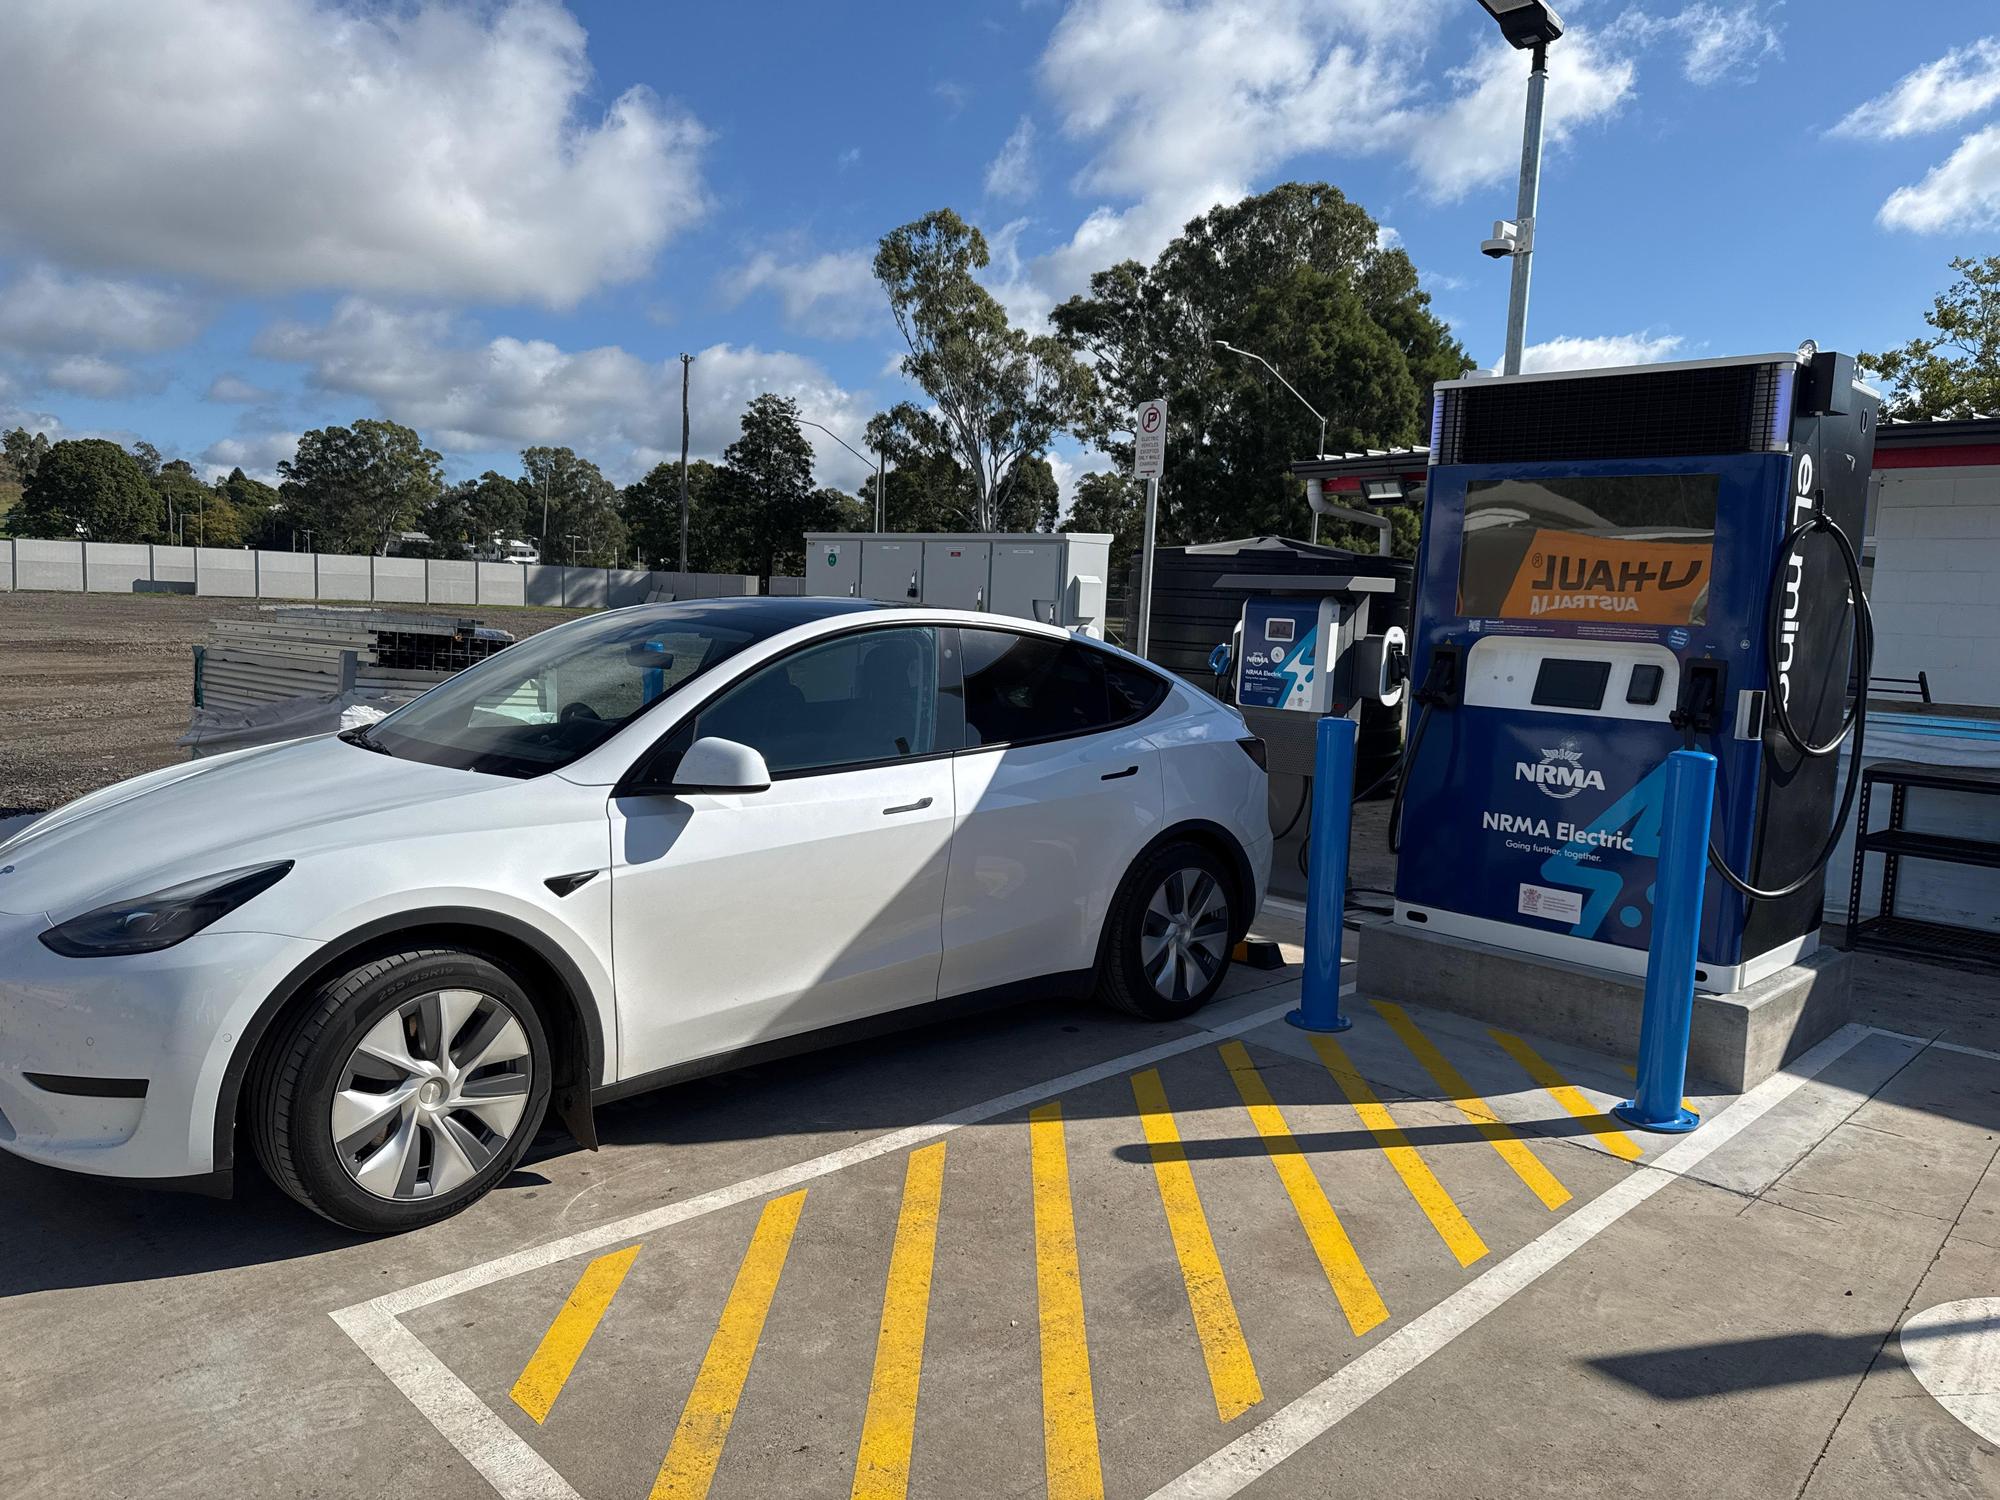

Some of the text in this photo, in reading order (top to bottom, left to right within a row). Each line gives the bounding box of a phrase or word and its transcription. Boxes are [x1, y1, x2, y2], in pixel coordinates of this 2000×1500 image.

[1246, 656, 1269, 664] NRMA
[1263, 670, 1282, 678] Electric
[1515, 762, 1606, 791] NRMA
[1482, 811, 1634, 851] NRMA Electric
[1505, 839, 1603, 862] Going further, together.
